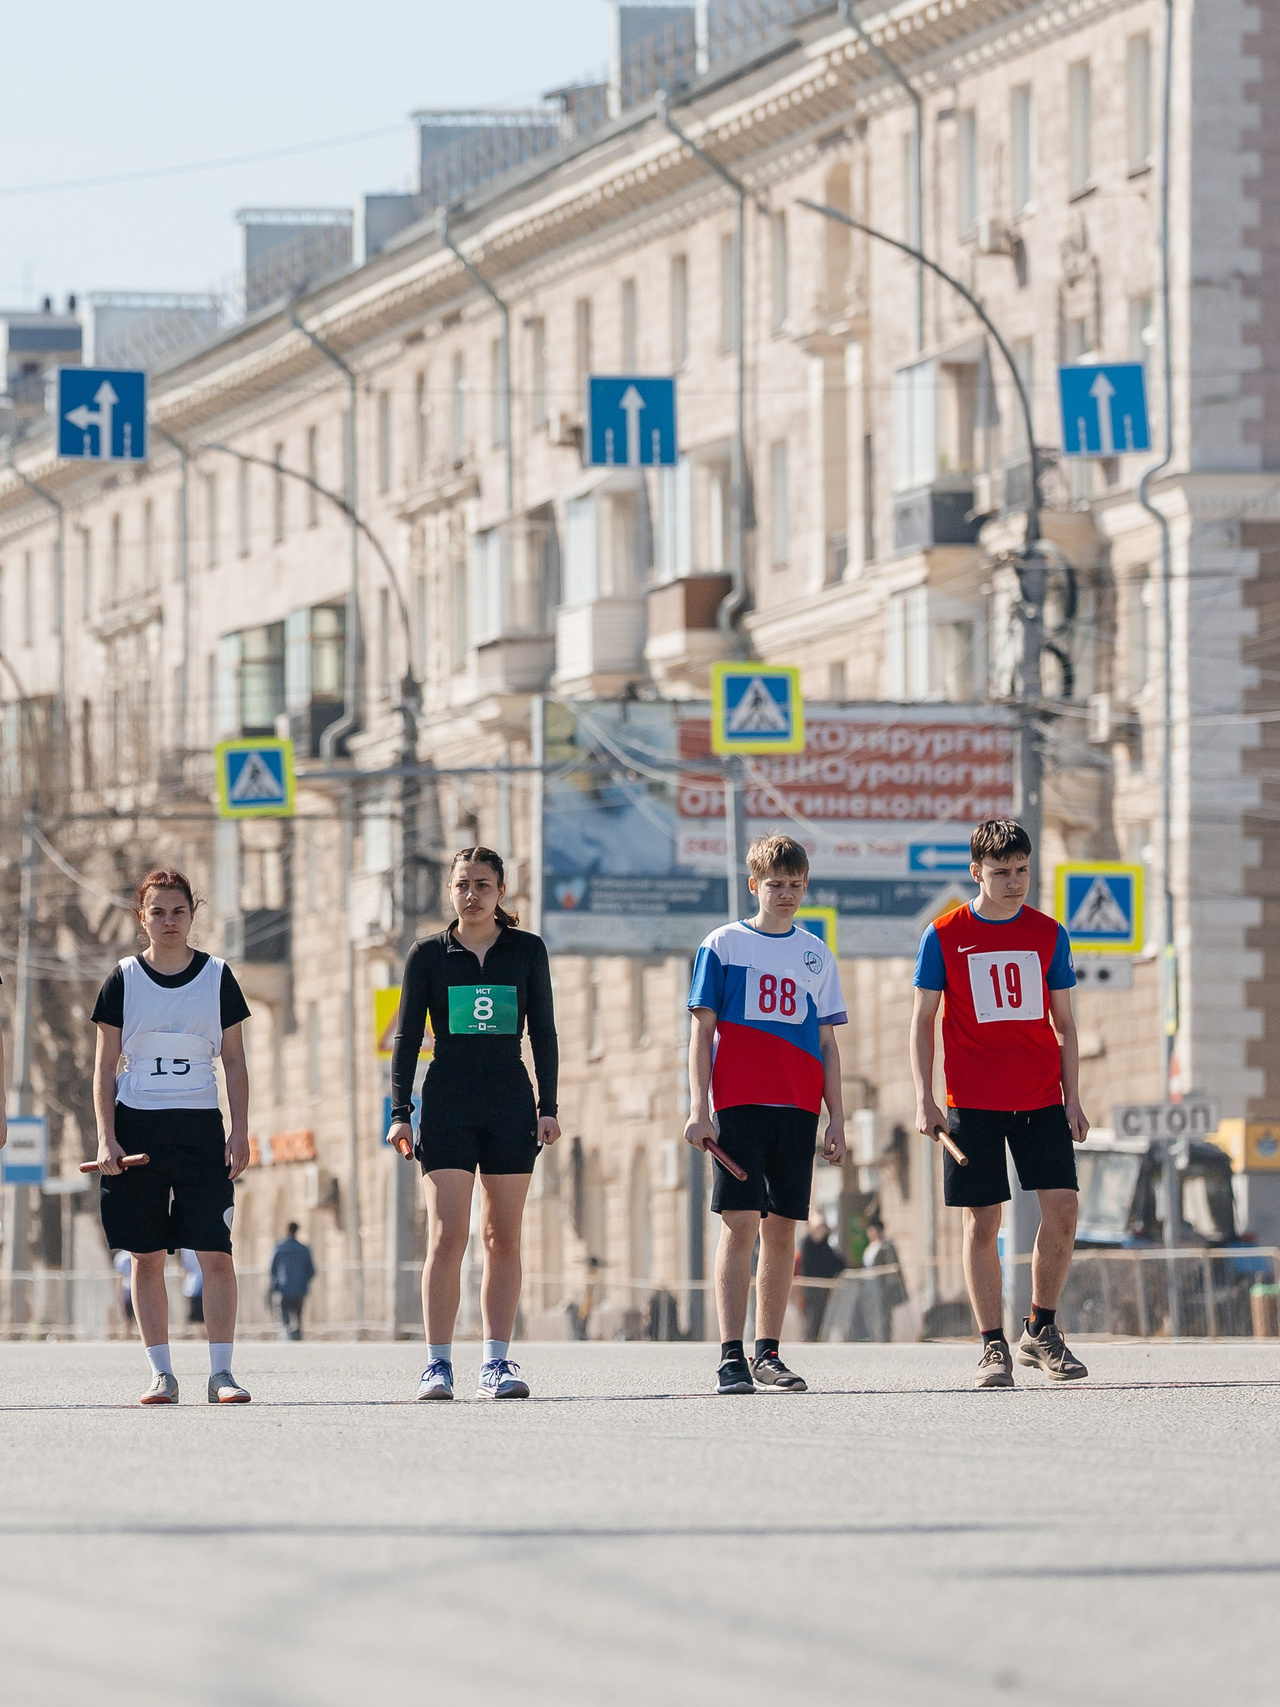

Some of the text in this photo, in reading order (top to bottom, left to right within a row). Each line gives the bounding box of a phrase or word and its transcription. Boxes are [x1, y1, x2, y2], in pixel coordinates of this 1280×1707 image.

[758, 973, 797, 1017] 88
[989, 962, 1023, 1009] 19
[473, 996, 494, 1021] 8
[150, 1057, 191, 1076] 15
[1122, 1106, 1211, 1136] СТОП
